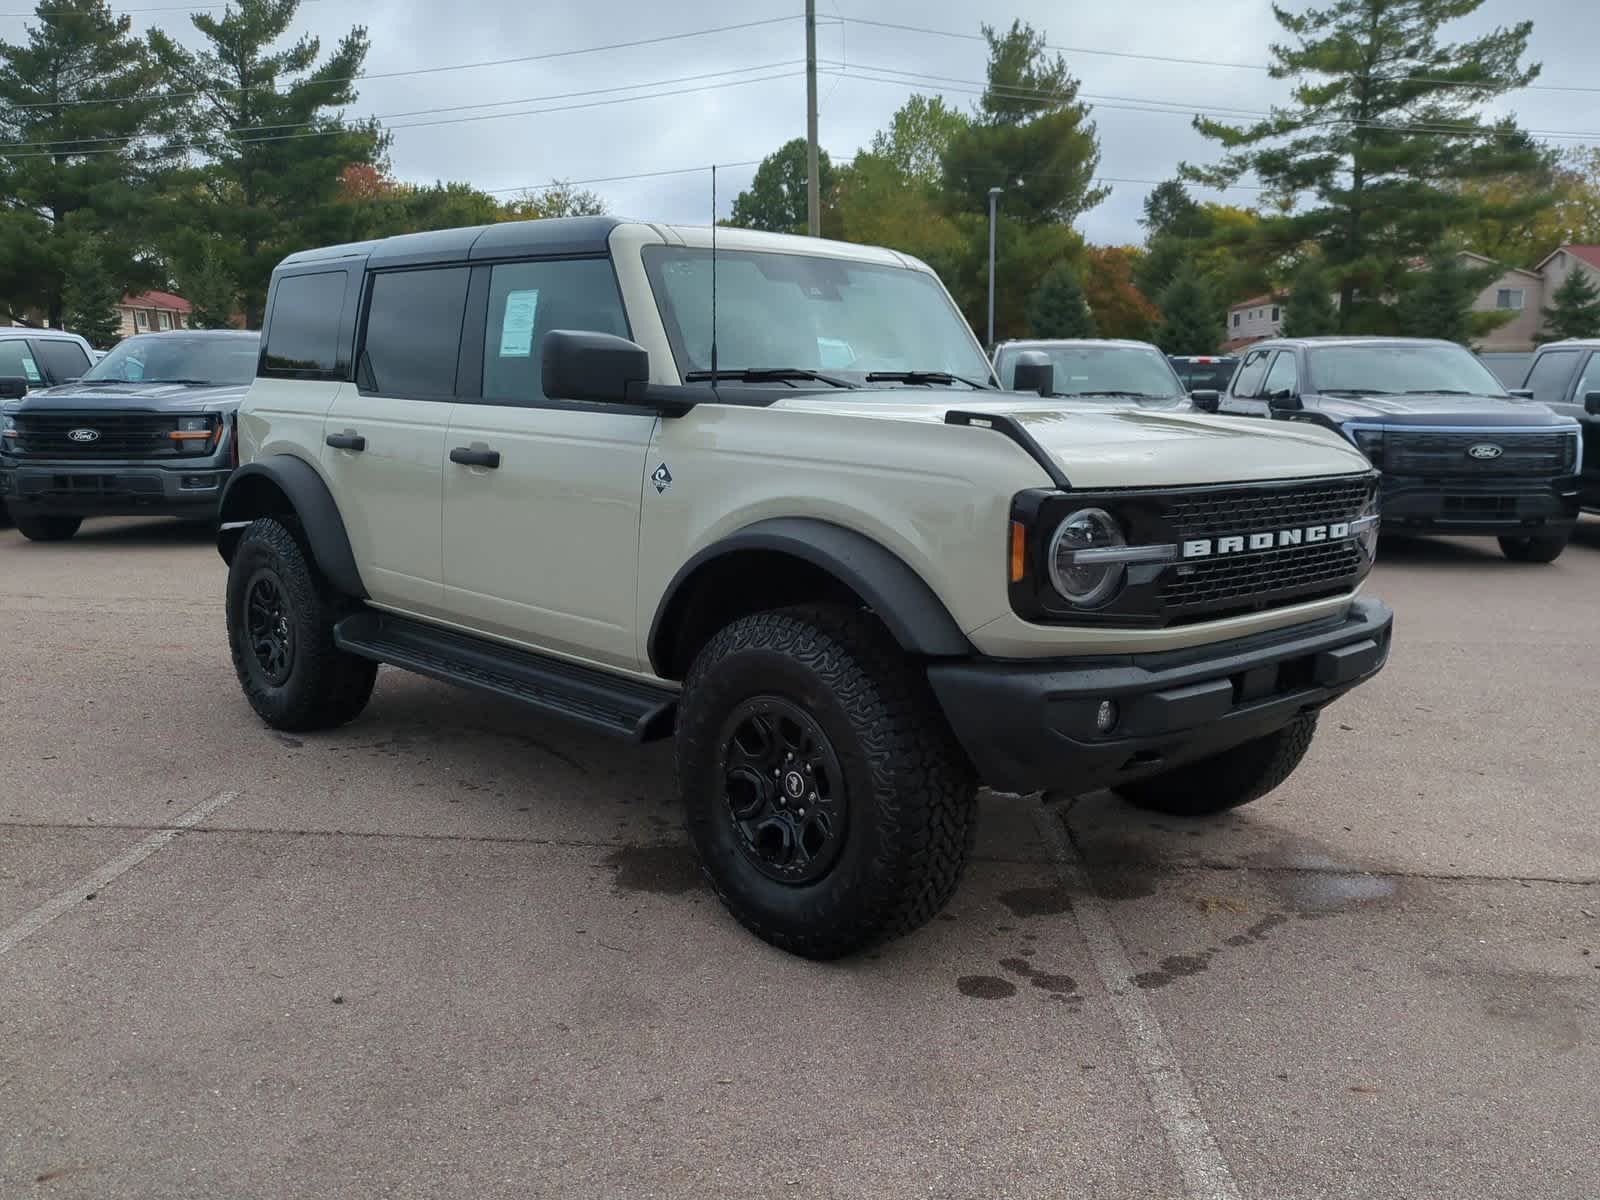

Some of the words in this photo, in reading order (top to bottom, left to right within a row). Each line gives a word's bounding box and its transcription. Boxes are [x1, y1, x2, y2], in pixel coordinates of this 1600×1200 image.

[71, 430, 97, 441] Ford
[1472, 446, 1499, 458] Ford
[1184, 523, 1349, 557] BRONCO
